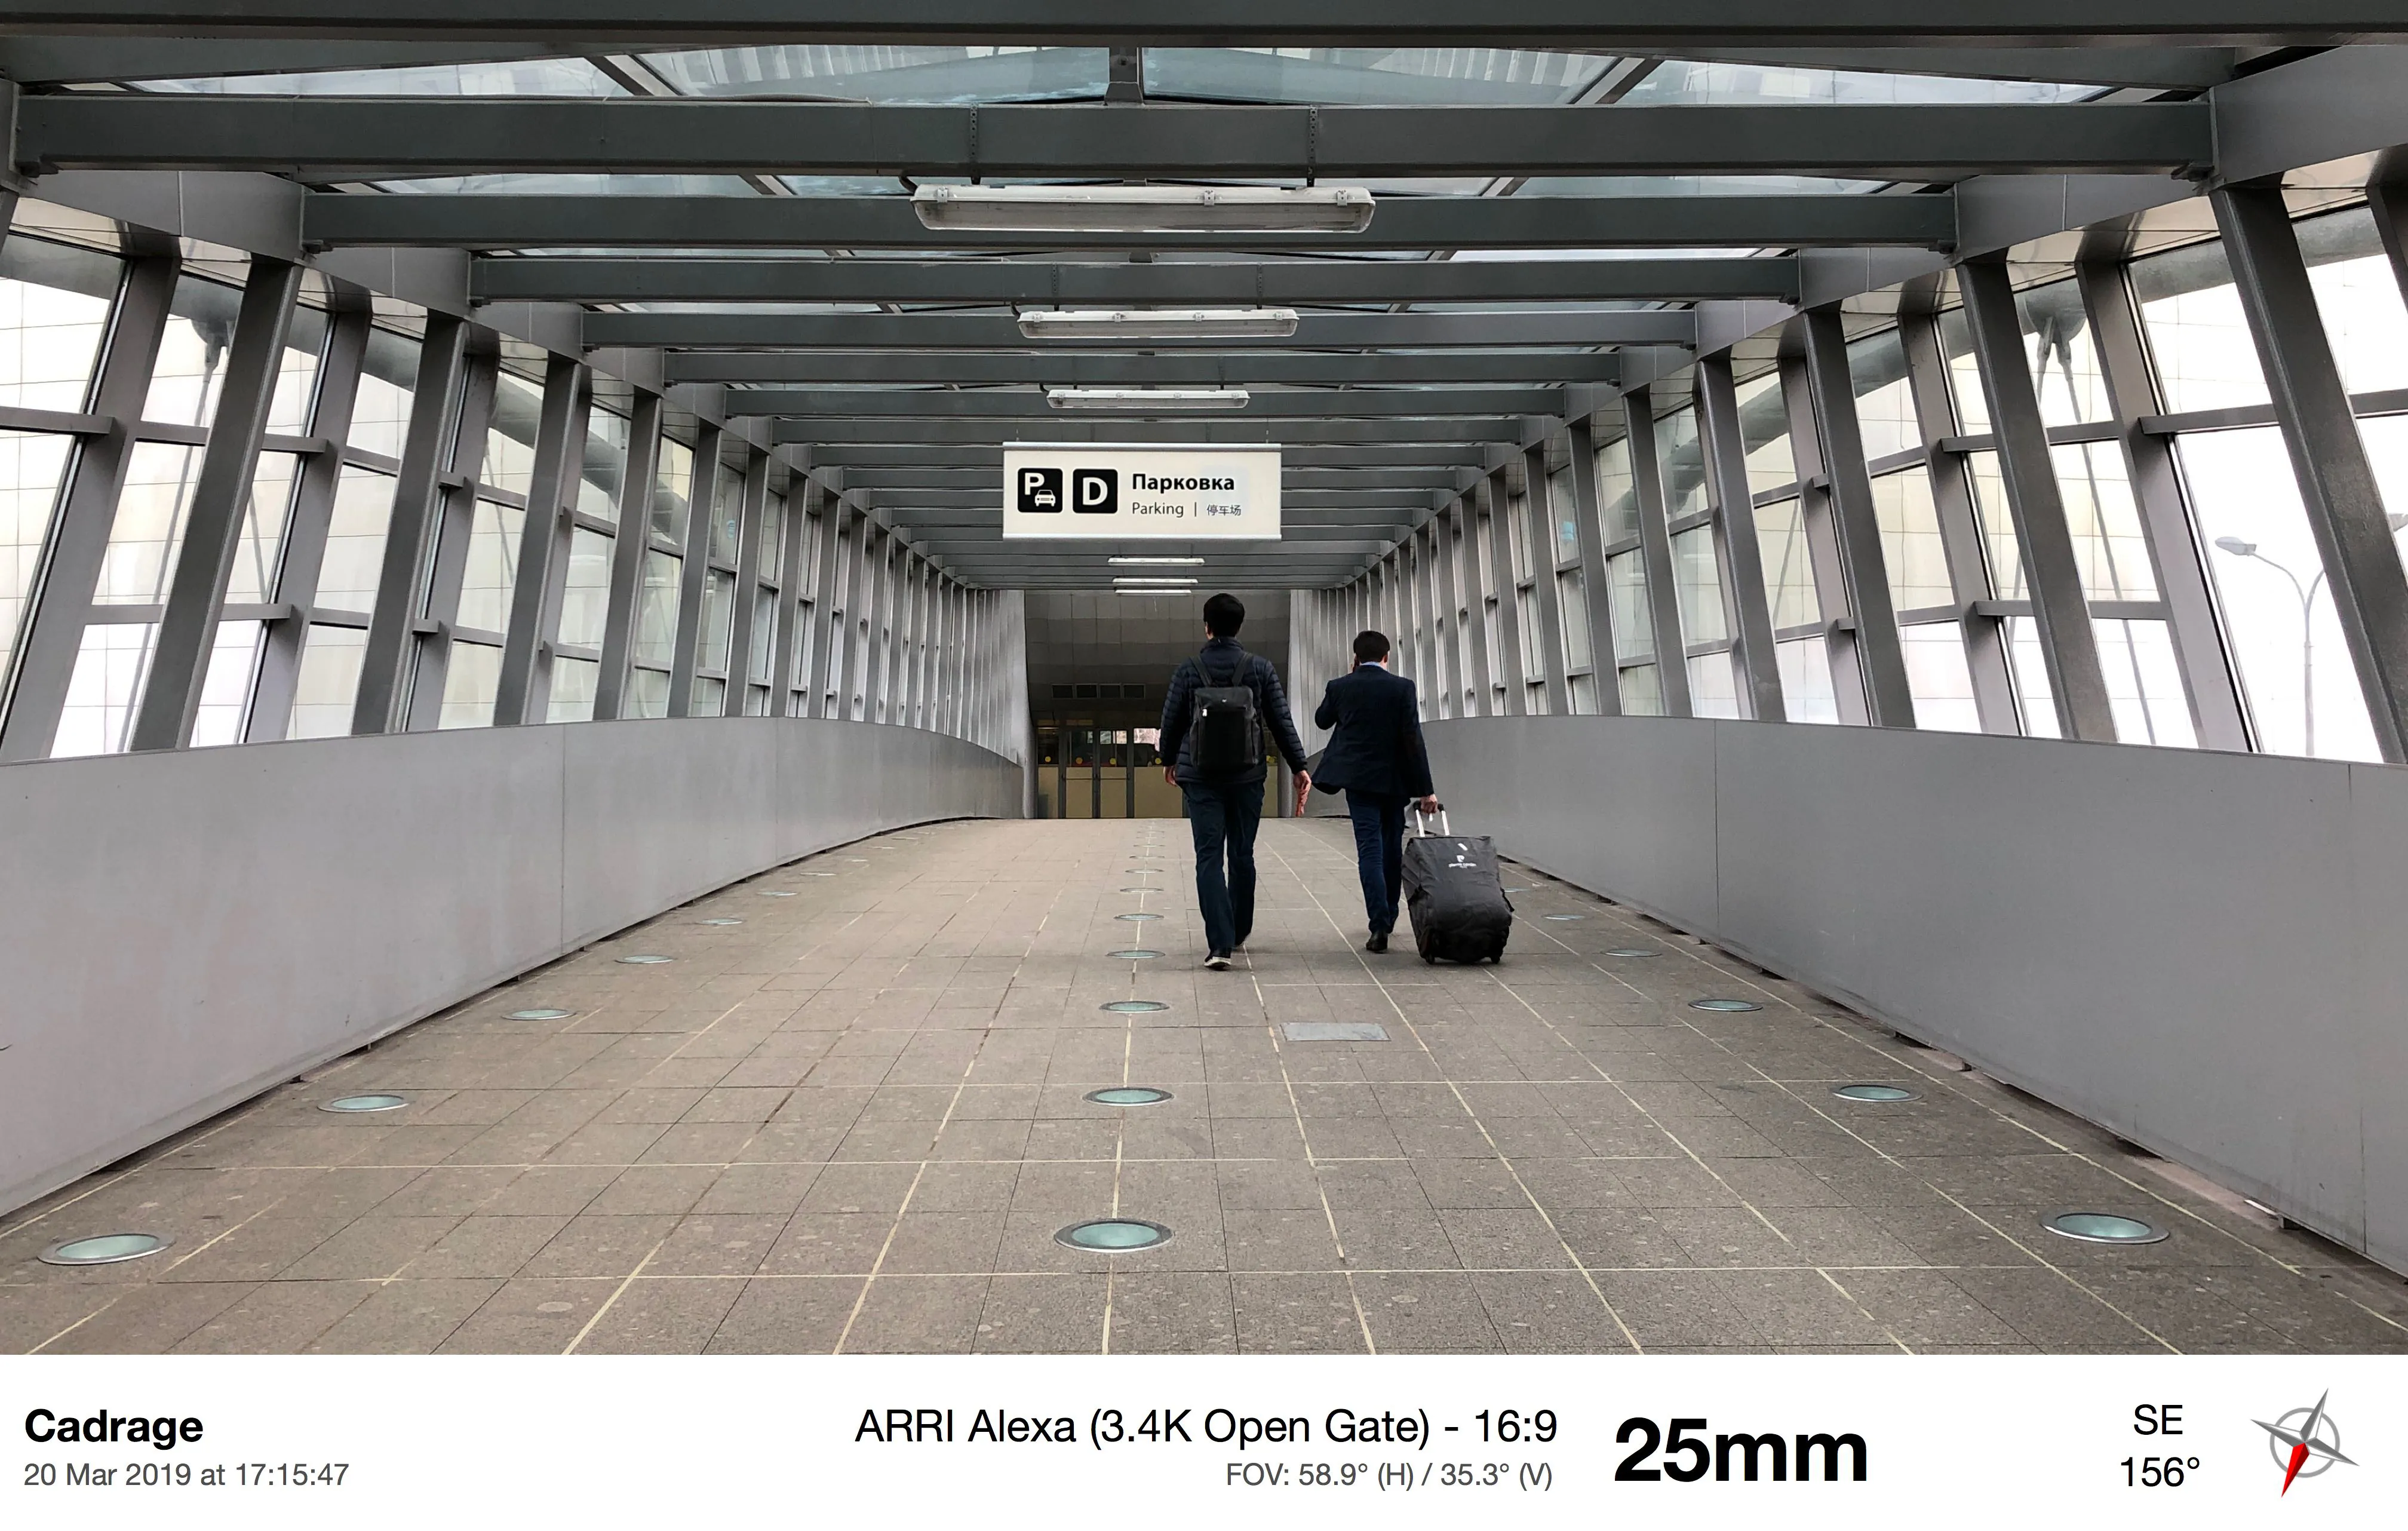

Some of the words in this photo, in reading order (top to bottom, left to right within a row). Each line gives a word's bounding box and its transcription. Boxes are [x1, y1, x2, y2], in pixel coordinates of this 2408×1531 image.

[1024, 473, 1045, 495] P
[1082, 477, 1108, 505] D
[1132, 473, 1234, 494] Парковка
[1132, 502, 1184, 518] Parking
[1206, 504, 1242, 516] 停车场
